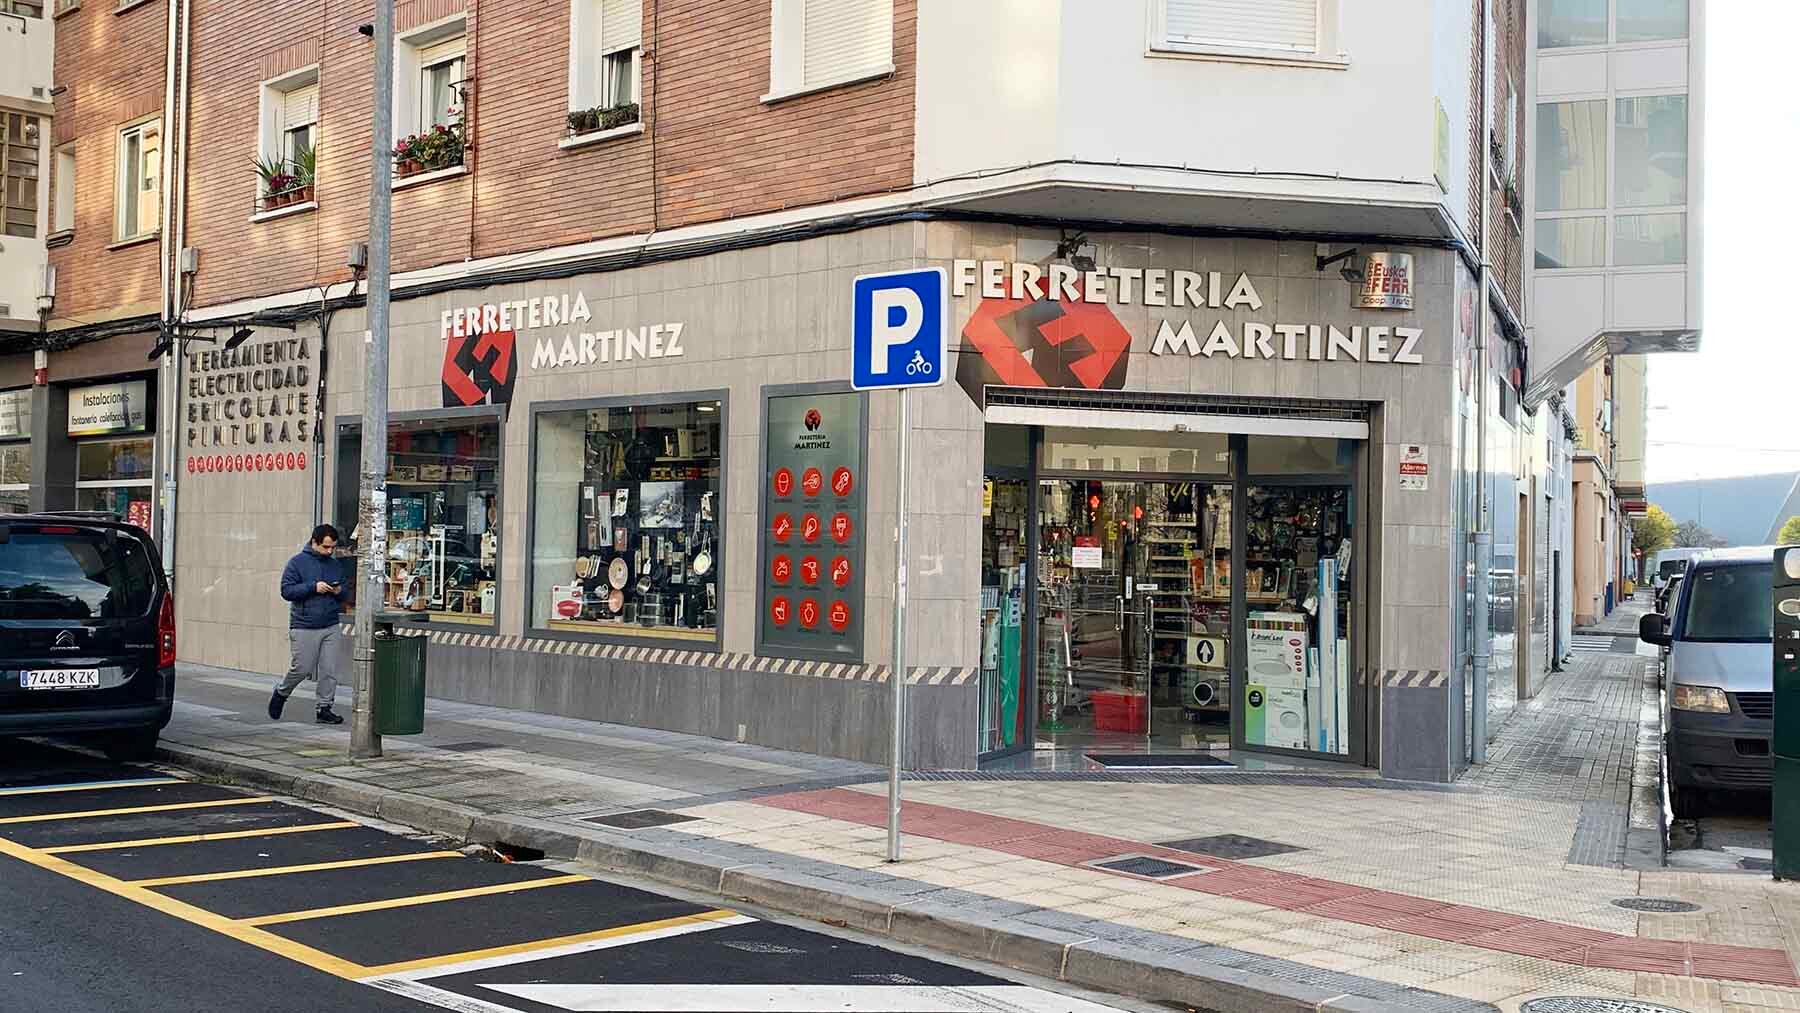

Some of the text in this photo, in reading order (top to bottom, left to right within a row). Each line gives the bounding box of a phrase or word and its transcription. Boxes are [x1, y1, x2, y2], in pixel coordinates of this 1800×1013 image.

[952, 258, 1263, 311] FERRETERIA
[441, 291, 592, 340] FERRETERIA
[870, 287, 923, 375] P
[189, 338, 310, 373] HERRAMIENTA
[531, 322, 685, 369] MARTINEZ
[1150, 318, 1425, 364] MARTINEZ
[189, 365, 309, 398] ELECTRICIDAD
[83, 391, 130, 408] Instalaciones
[188, 392, 308, 423] BRICOLAJE
[187, 419, 308, 448] PINTURAS
[793, 441, 831, 450] MARTINEZ
[30, 672, 96, 685] 7448 KZK
